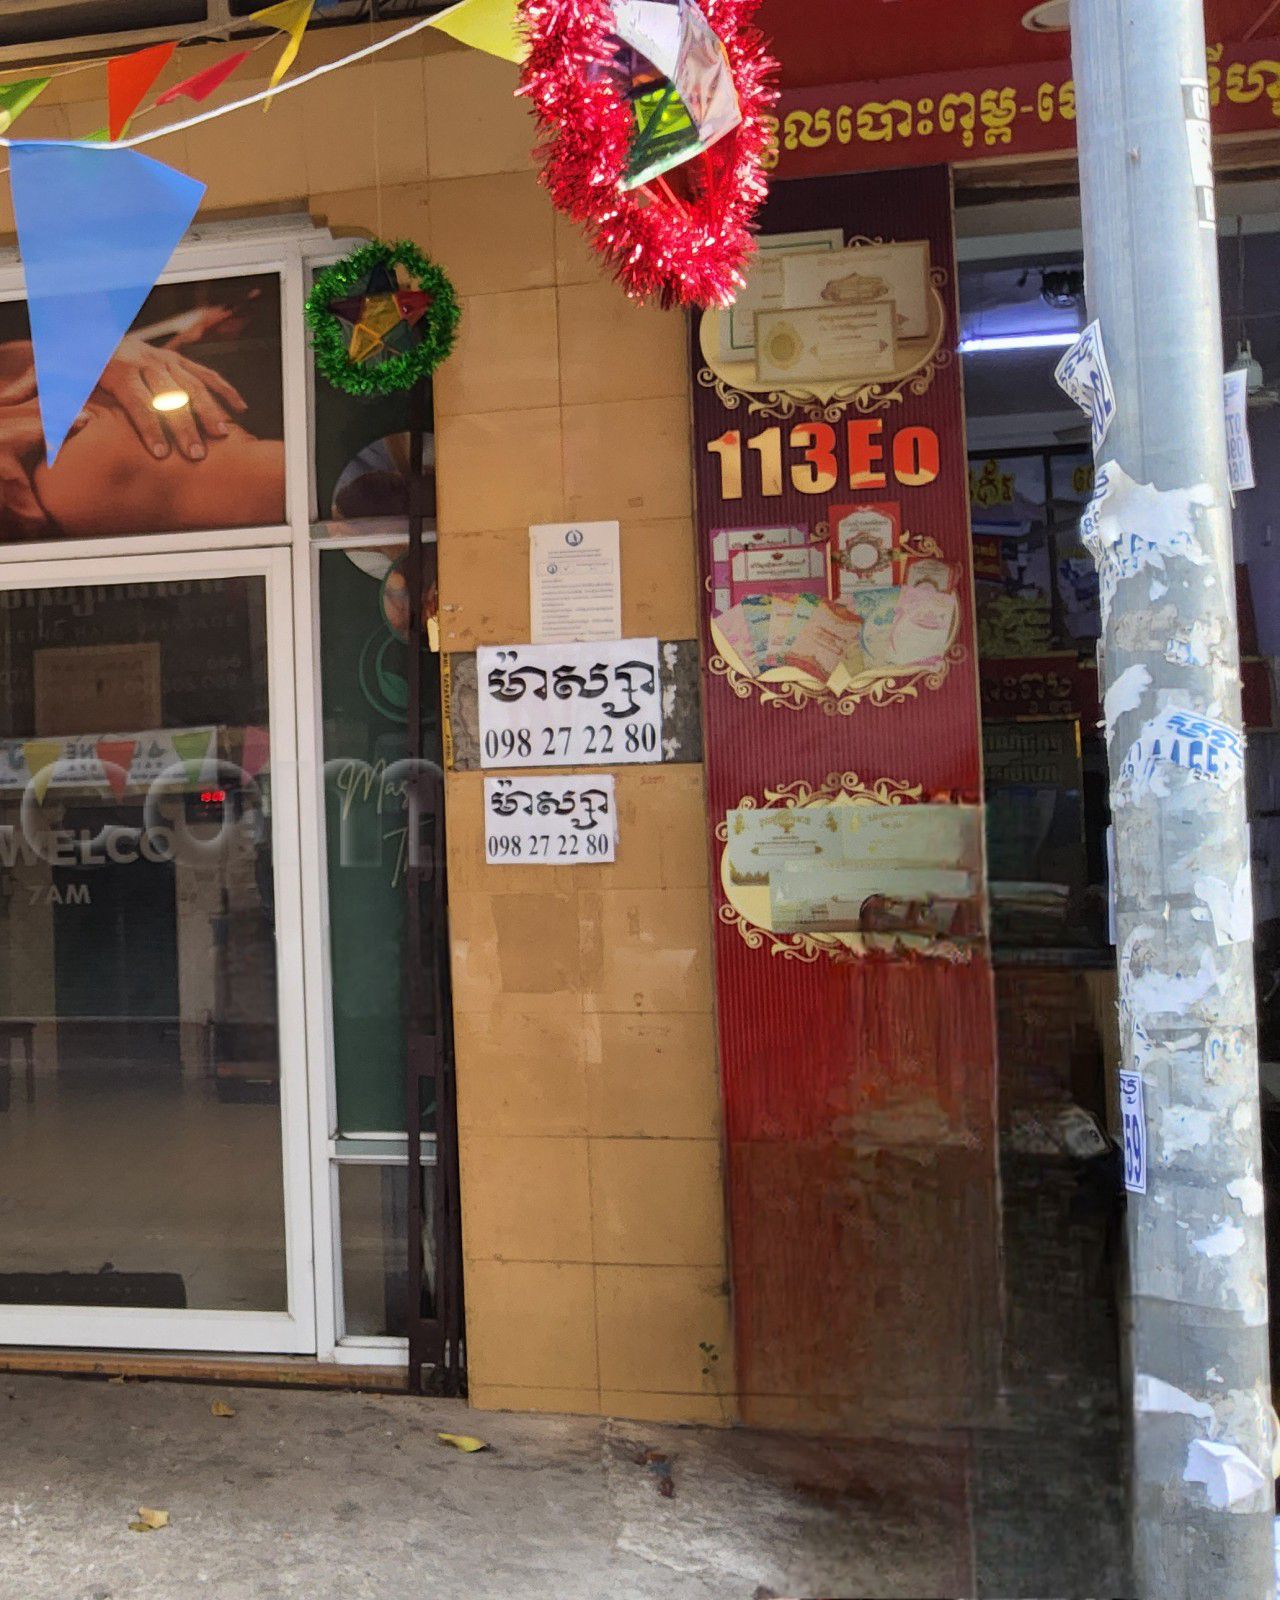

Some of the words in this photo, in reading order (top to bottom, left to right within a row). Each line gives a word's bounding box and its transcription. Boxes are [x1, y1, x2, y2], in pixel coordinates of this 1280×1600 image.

[485, 728, 533, 759] 098
[542, 726, 572, 756] 27
[583, 725, 615, 754] 22
[624, 722, 657, 753] 80
[488, 836, 521, 858] 098
[528, 835, 550, 857] 27
[558, 834, 580, 856] 22
[587, 833, 609, 855] 80
[29, 883, 92, 905] 7AM
